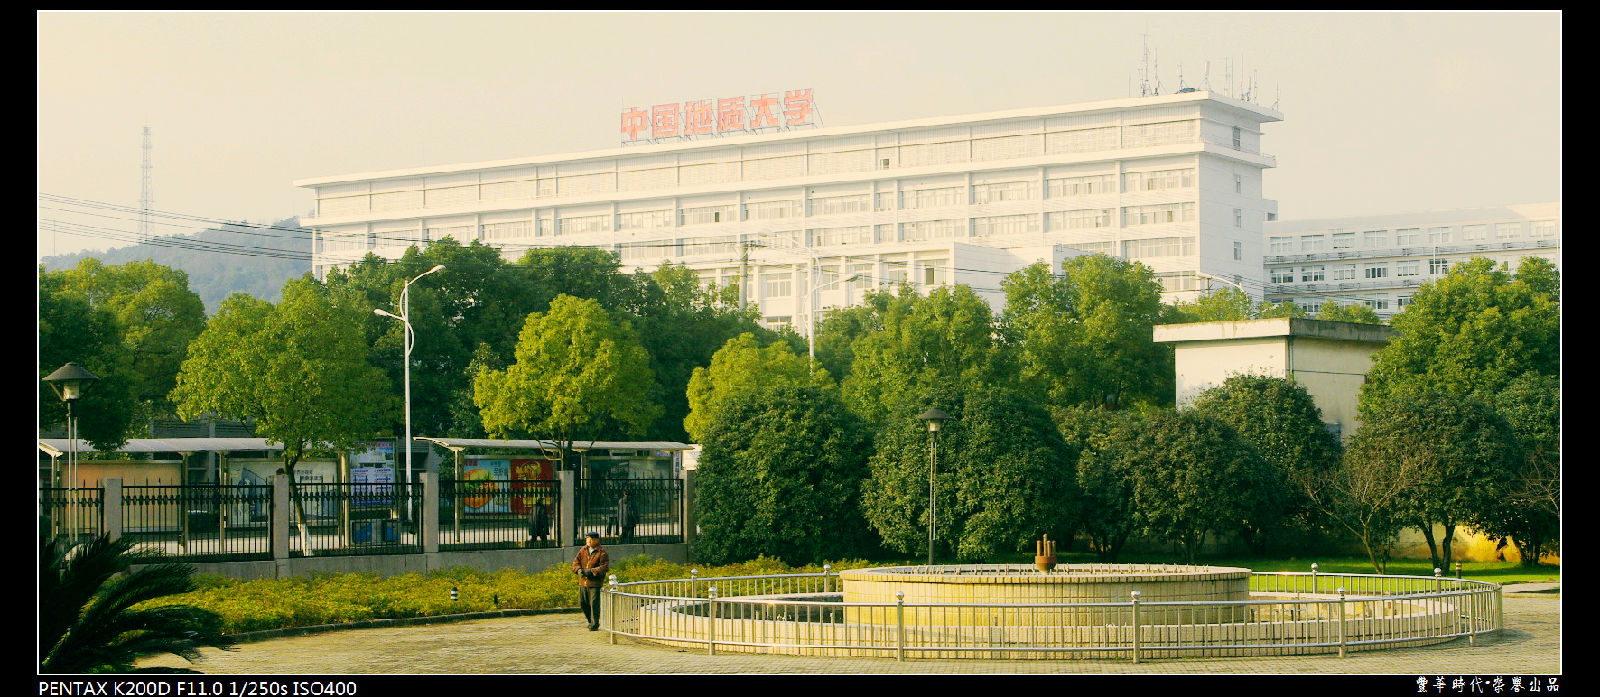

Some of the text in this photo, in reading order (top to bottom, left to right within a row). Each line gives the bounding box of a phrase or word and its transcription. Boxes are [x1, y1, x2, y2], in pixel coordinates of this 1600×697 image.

[620, 88, 814, 140] 中国地质大学
